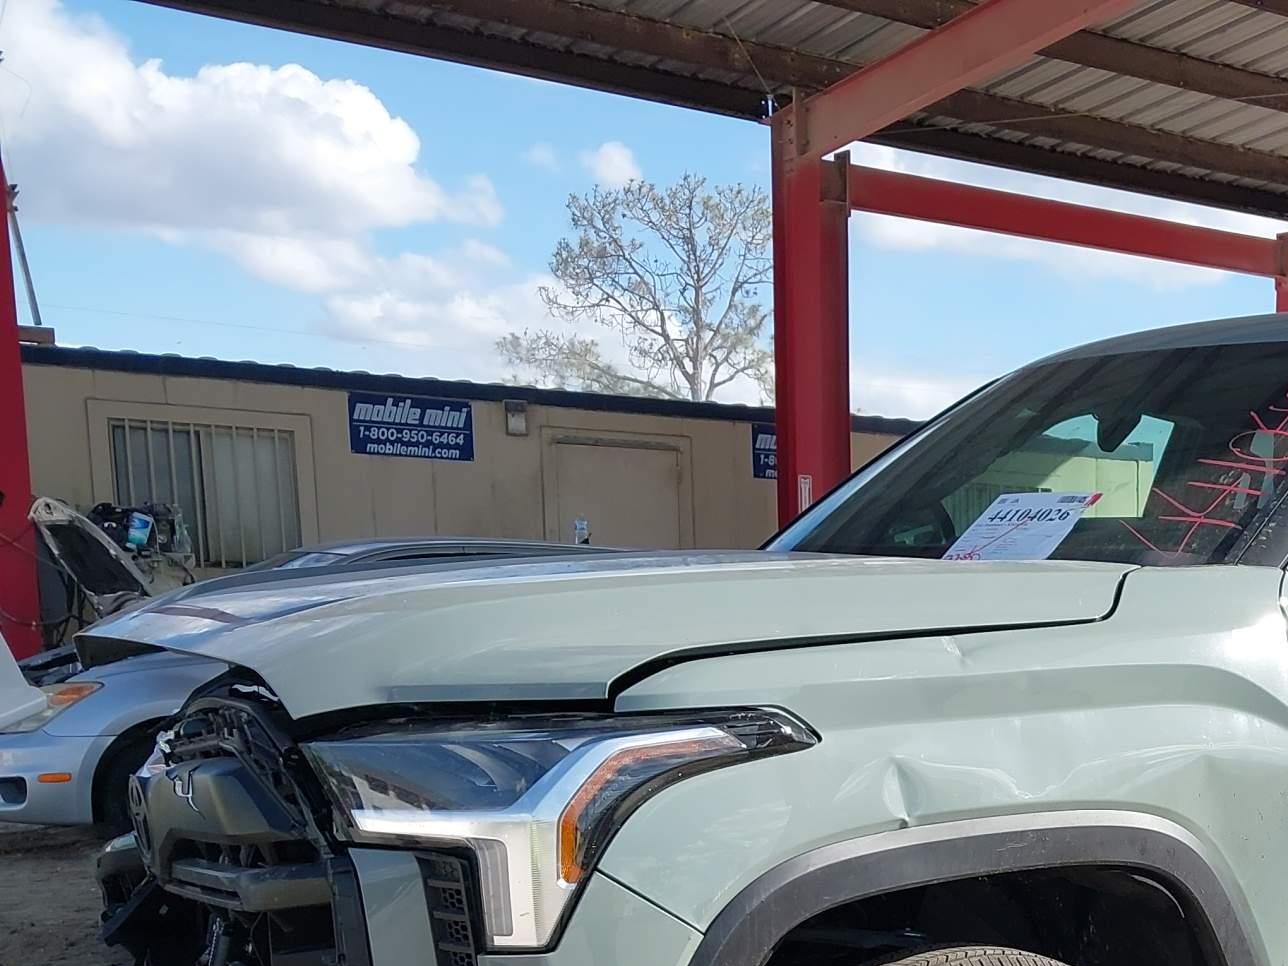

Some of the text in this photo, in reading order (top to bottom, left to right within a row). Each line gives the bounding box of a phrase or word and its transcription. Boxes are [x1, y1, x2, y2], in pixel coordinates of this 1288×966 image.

[353, 397, 468, 428] mobile mini
[359, 426, 464, 445] 1-800-950-6464
[366, 442, 460, 459] mobilemini.com
[988, 508, 1071, 523] 44104026
